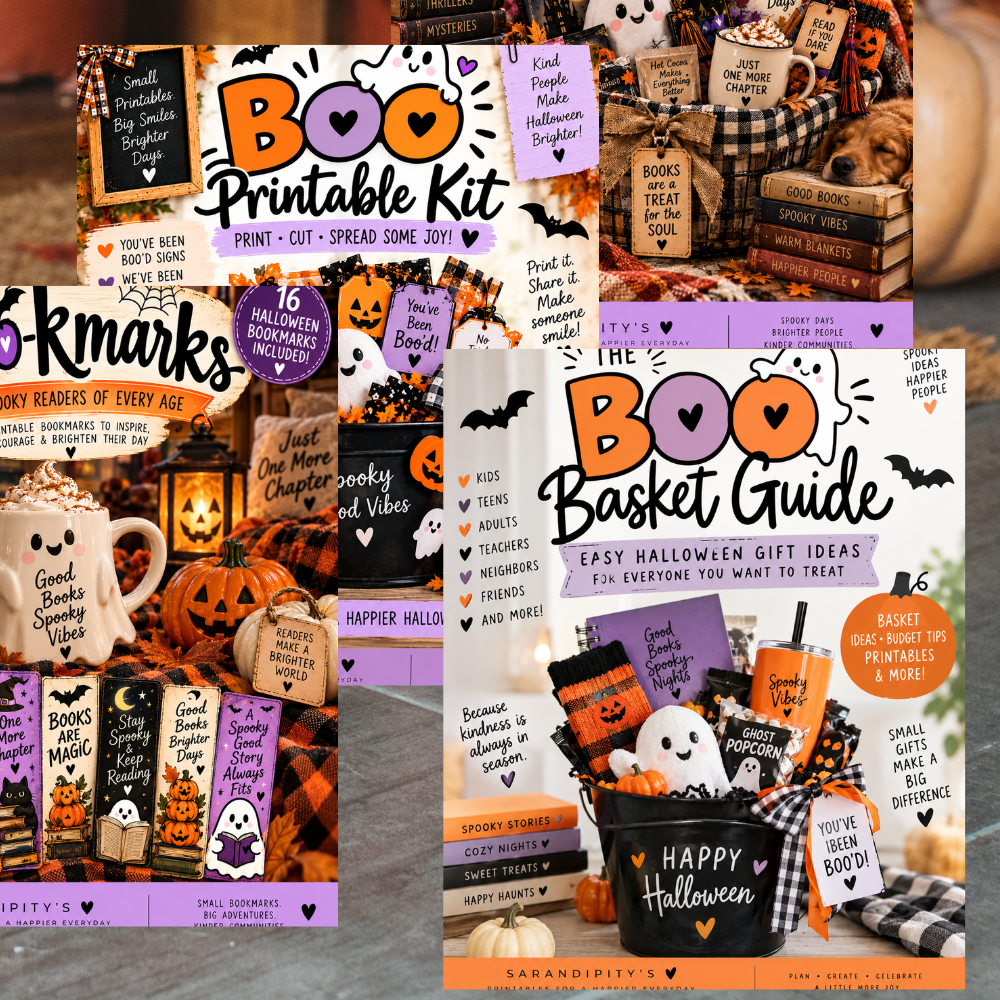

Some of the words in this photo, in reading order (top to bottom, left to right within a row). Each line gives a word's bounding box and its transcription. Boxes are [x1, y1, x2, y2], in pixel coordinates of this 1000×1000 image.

[427, 20, 477, 37] MYSTERIES
[534, 53, 560, 71] Kind
[736, 59, 760, 70] JUST
[531, 72, 568, 92] People
[724, 70, 744, 80] ONE
[746, 72, 772, 82] MORE
[726, 82, 767, 94] CHAPTER
[537, 91, 569, 108] Make
[526, 111, 584, 130] Halloween
[532, 124, 582, 148] Brighter!
[786, 186, 812, 200] GOOD
[818, 191, 850, 206] BOOKS
[779, 208, 816, 224] SPOOKY
[821, 216, 848, 230] VIBES
[775, 234, 802, 248] WARM
[806, 240, 852, 259] BLANKETS
[772, 260, 808, 278] HAPPIER
[814, 268, 847, 286] PEOPLE
[408, 298, 440, 316] You've
[407, 315, 432, 332] Been
[394, 330, 440, 352] Boo'd!
[278, 426, 320, 454] Just
[258, 457, 286, 480] One
[290, 450, 333, 472] More
[265, 470, 333, 502] Chapter
[366, 494, 411, 518] Vibes
[35, 561, 76, 590] Good
[40, 584, 86, 609] Books
[33, 604, 86, 632] Spooky
[48, 626, 86, 646] Vibes
[769, 672, 807, 694] Spooky
[771, 690, 808, 708] Vibes
[0, 715, 22, 729] One
[742, 727, 776, 742] GHOST
[726, 738, 782, 760] POPCORN
[817, 816, 857, 836] YOU'VE
[663, 846, 742, 872] HAPPY
[824, 850, 870, 876] BOO'D!
[642, 873, 755, 918] Halloween
